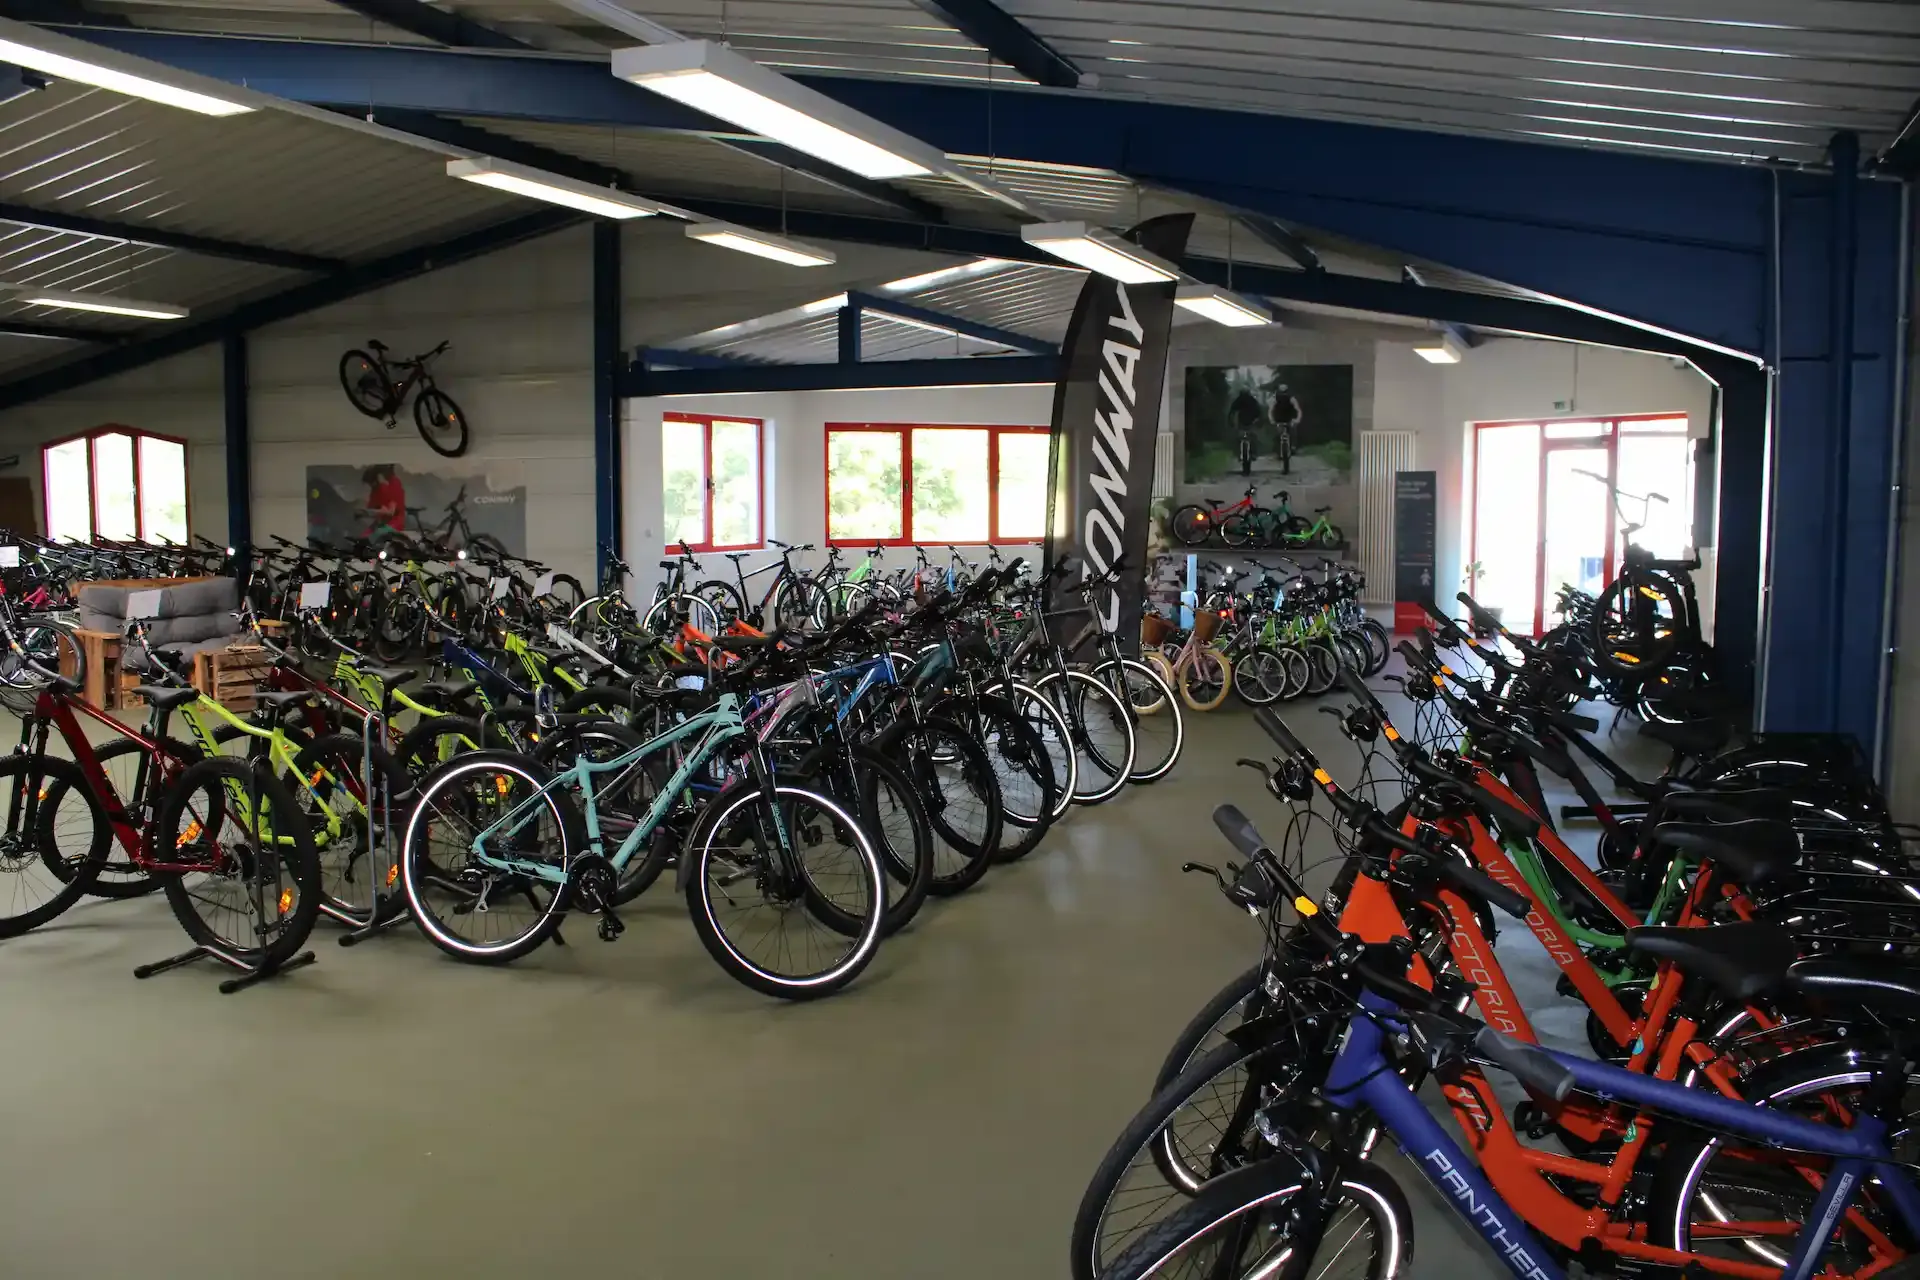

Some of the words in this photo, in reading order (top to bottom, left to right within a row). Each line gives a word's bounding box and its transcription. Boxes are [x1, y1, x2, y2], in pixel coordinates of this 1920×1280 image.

[473, 493, 516, 506] CONY
[1082, 280, 1144, 633] CONWAY
[1486, 860, 1574, 965] VICORIA
